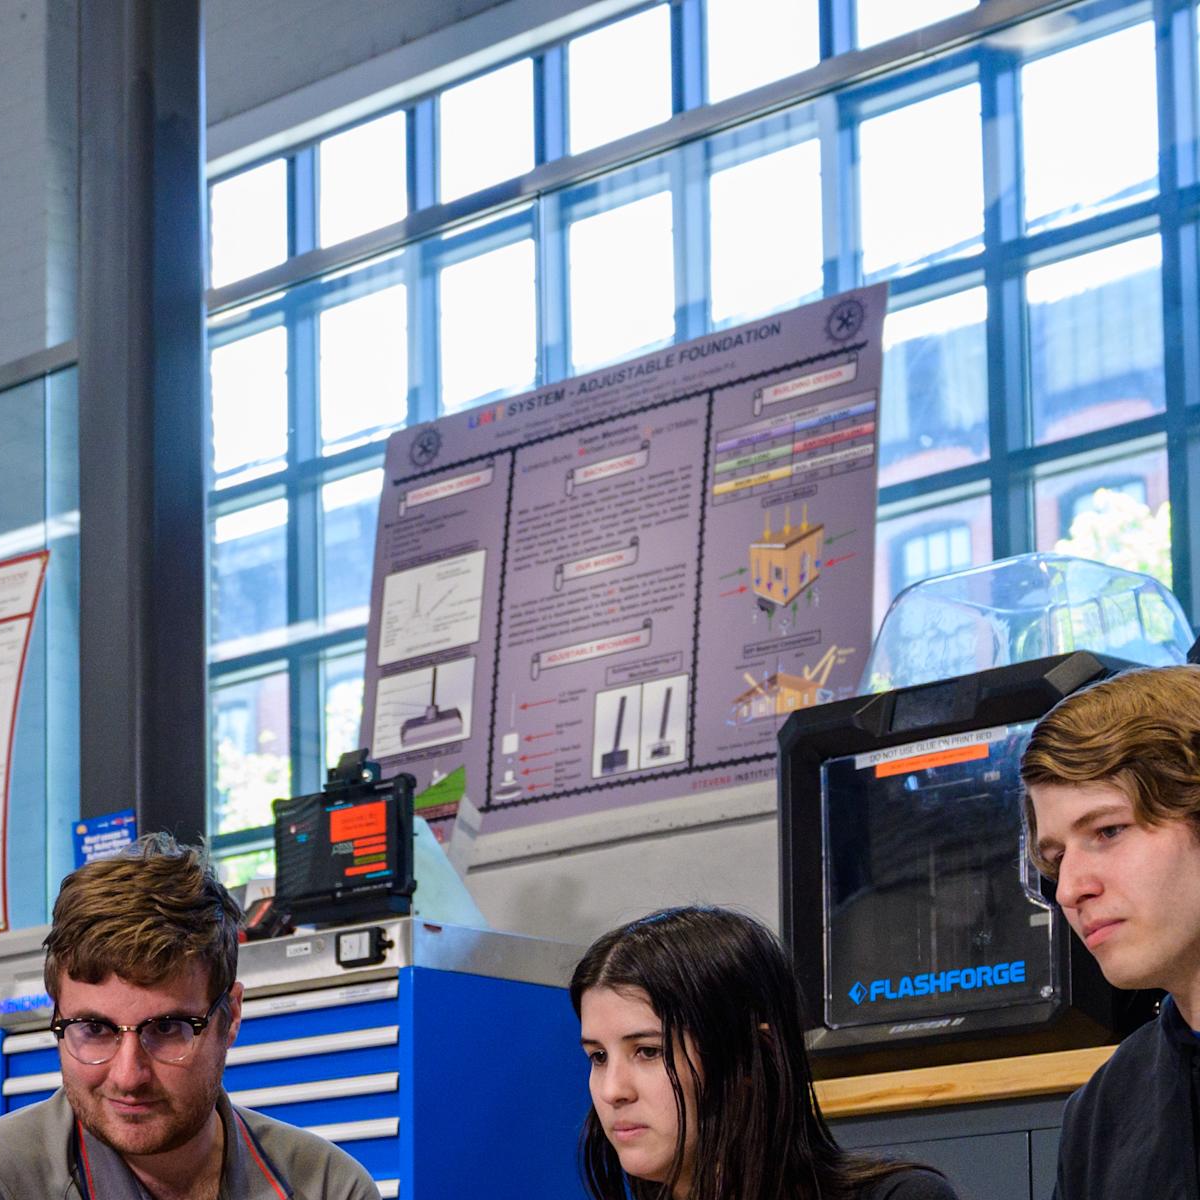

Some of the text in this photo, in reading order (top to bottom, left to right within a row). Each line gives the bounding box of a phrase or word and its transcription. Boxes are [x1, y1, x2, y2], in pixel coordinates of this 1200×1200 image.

[507, 388, 565, 417] SYSTEM
[577, 354, 676, 396] ADJUSTABLE
[679, 322, 782, 365] FOUNDATION
[869, 752, 883, 763] DO
[883, 748, 899, 761] NOT
[899, 743, 916, 756] USE
[951, 733, 976, 746] PRINT
[976, 730, 993, 741] BED
[734, 768, 778, 782] INSTITUT
[869, 960, 1026, 1002] FLASHFORGE
